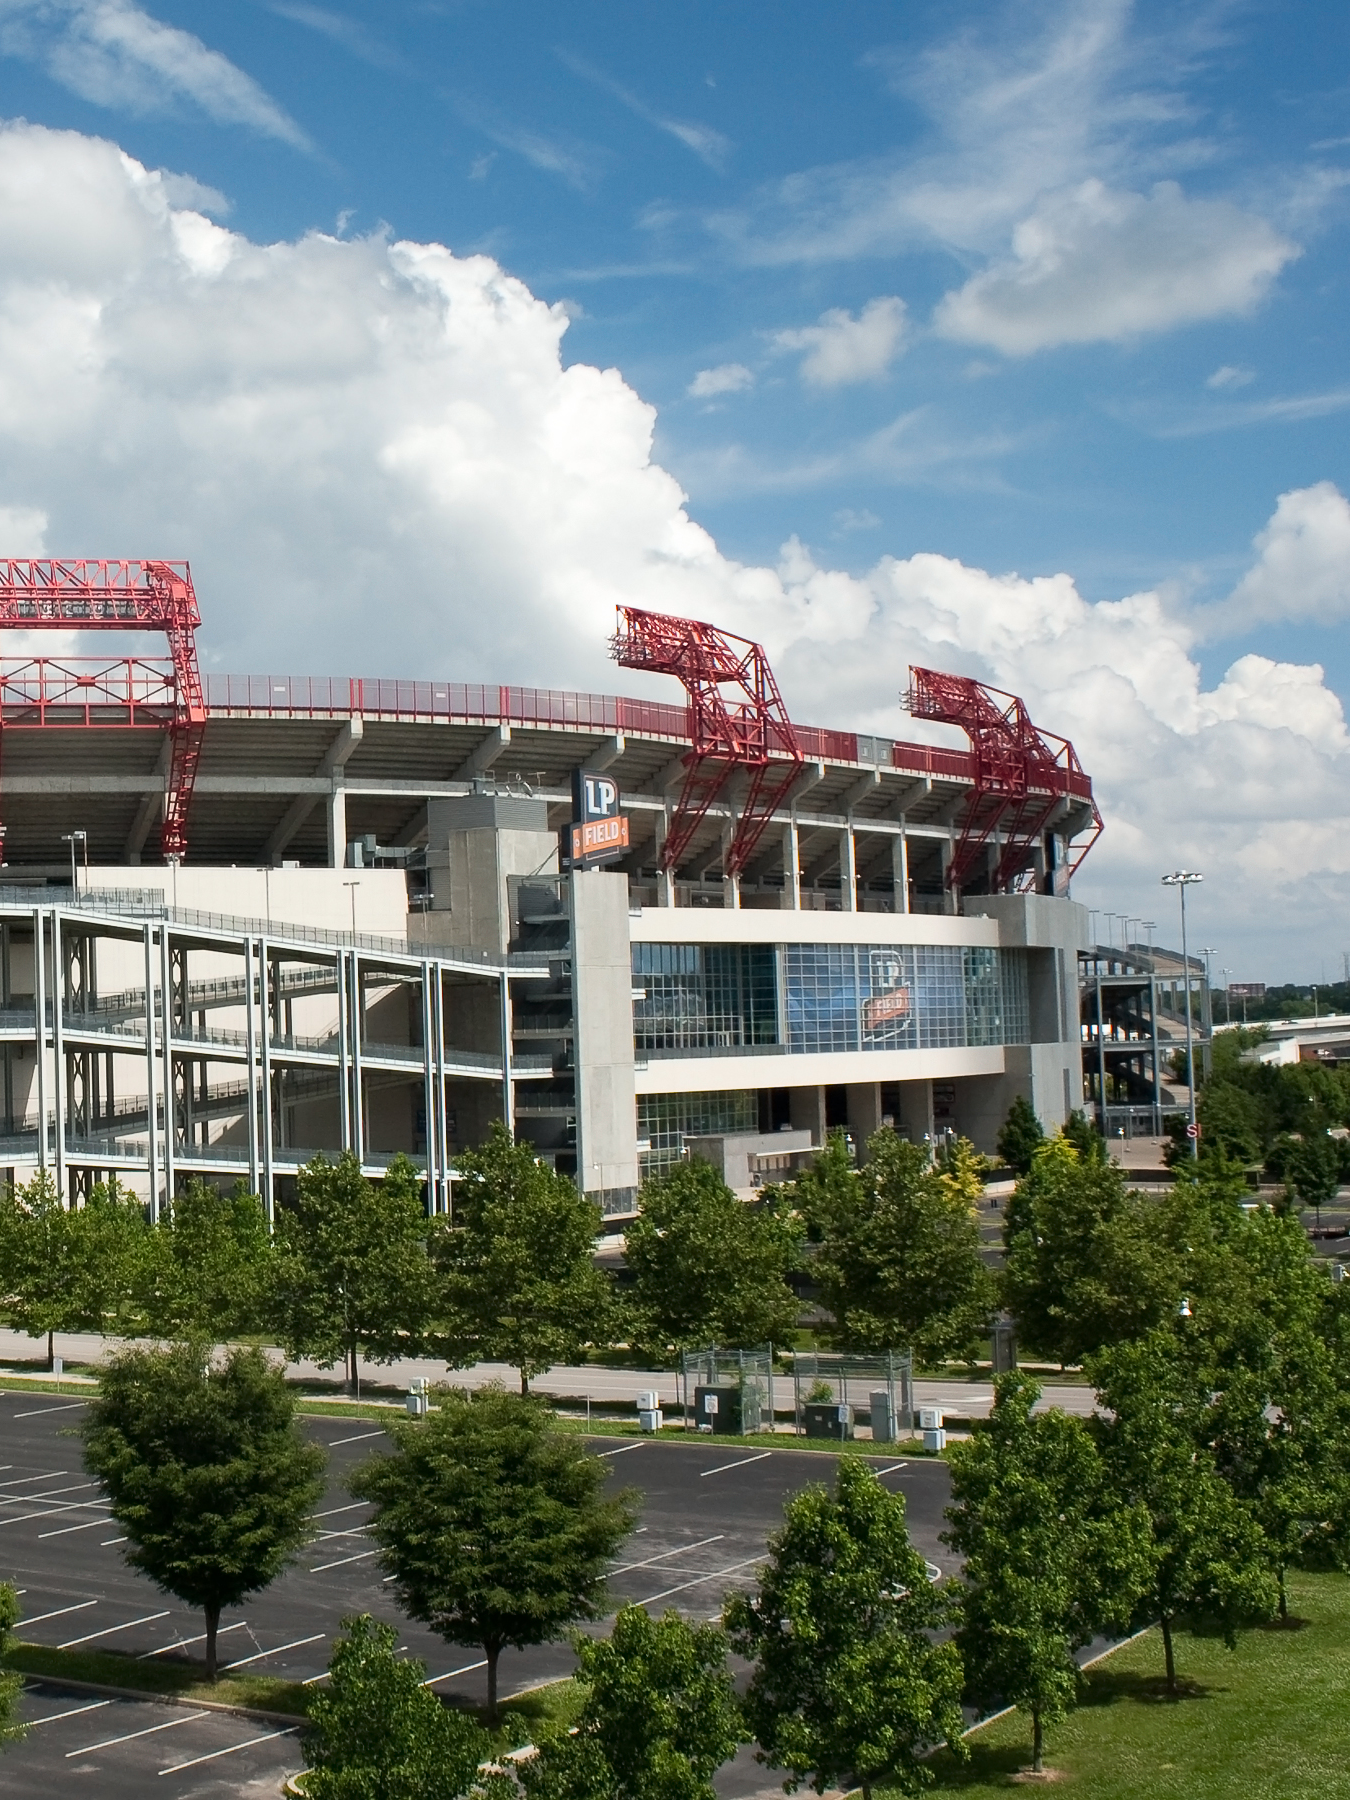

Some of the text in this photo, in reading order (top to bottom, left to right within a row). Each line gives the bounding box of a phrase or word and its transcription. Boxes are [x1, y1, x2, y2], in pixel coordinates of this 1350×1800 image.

[585, 780, 615, 814] LP
[585, 821, 619, 846] FIELD
[876, 961, 899, 988] LP
[876, 992, 903, 1018] FIELD
[1186, 1124, 1198, 1138] S
